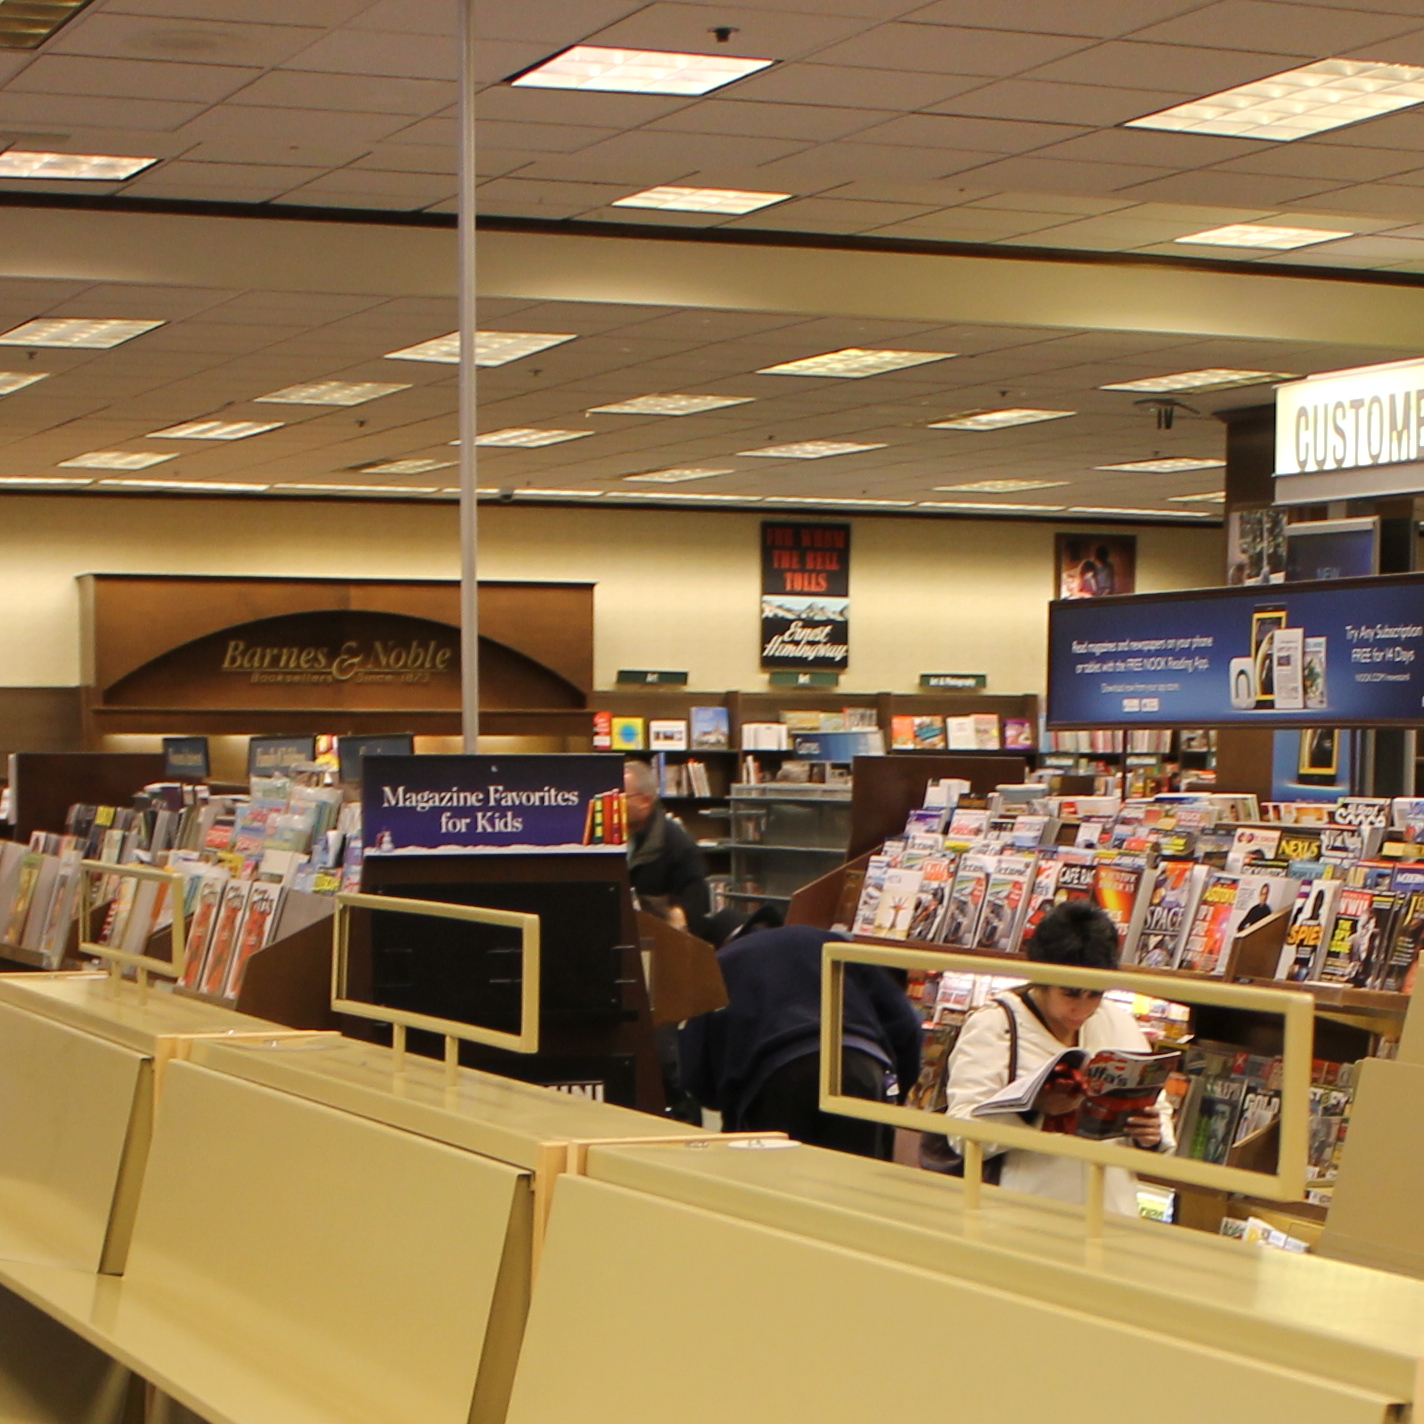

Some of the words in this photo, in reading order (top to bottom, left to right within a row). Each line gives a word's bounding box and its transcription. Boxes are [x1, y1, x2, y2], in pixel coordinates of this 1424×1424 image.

[773, 550, 800, 569] THE
[805, 551, 840, 570] BELL
[783, 572, 829, 592] TOLLS
[783, 620, 833, 642] Ernest
[1345, 625, 1358, 643] Try
[1359, 624, 1375, 643] Any
[1375, 623, 1424, 643] Subscription
[762, 635, 847, 661] Hemingway
[1351, 647, 1372, 663] FREE
[1372, 647, 1385, 662] for
[1393, 646, 1416, 665] Days
[222, 640, 327, 669] Barnes
[332, 641, 363, 680] &
[367, 640, 452, 669] Noble
[250, 672, 333, 684] Booksellers
[382, 786, 483, 812] Magazine
[488, 785, 579, 807] Favorites
[440, 812, 470, 833] for
[476, 812, 524, 833] Kids
[1278, 840, 1320, 858] NEXUS
